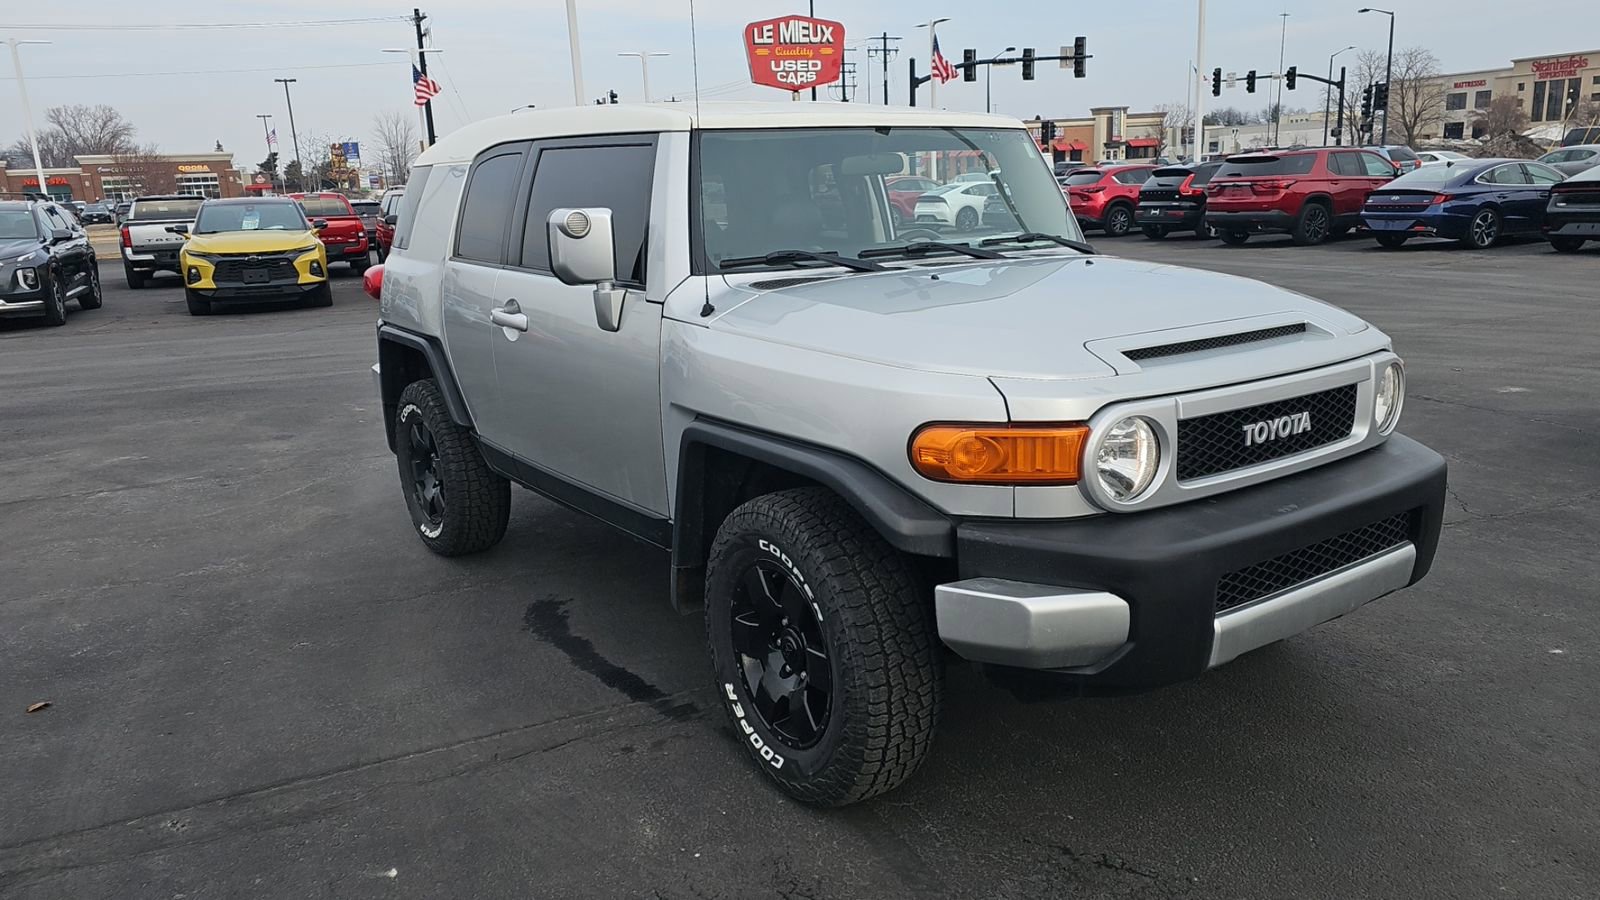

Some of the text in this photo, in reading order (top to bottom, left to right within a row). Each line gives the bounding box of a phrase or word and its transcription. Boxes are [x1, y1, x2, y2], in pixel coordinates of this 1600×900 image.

[752, 19, 834, 45] LE MIEUX
[774, 46, 815, 57] Quality
[771, 60, 821, 71] USED
[1531, 55, 1588, 72] Steinhafels
[777, 72, 817, 85] CARS
[1454, 80, 1487, 88] MATTRESSES
[1243, 411, 1312, 446] TOYOTA
[759, 539, 824, 622] COOPER
[724, 683, 785, 769] COOPER
